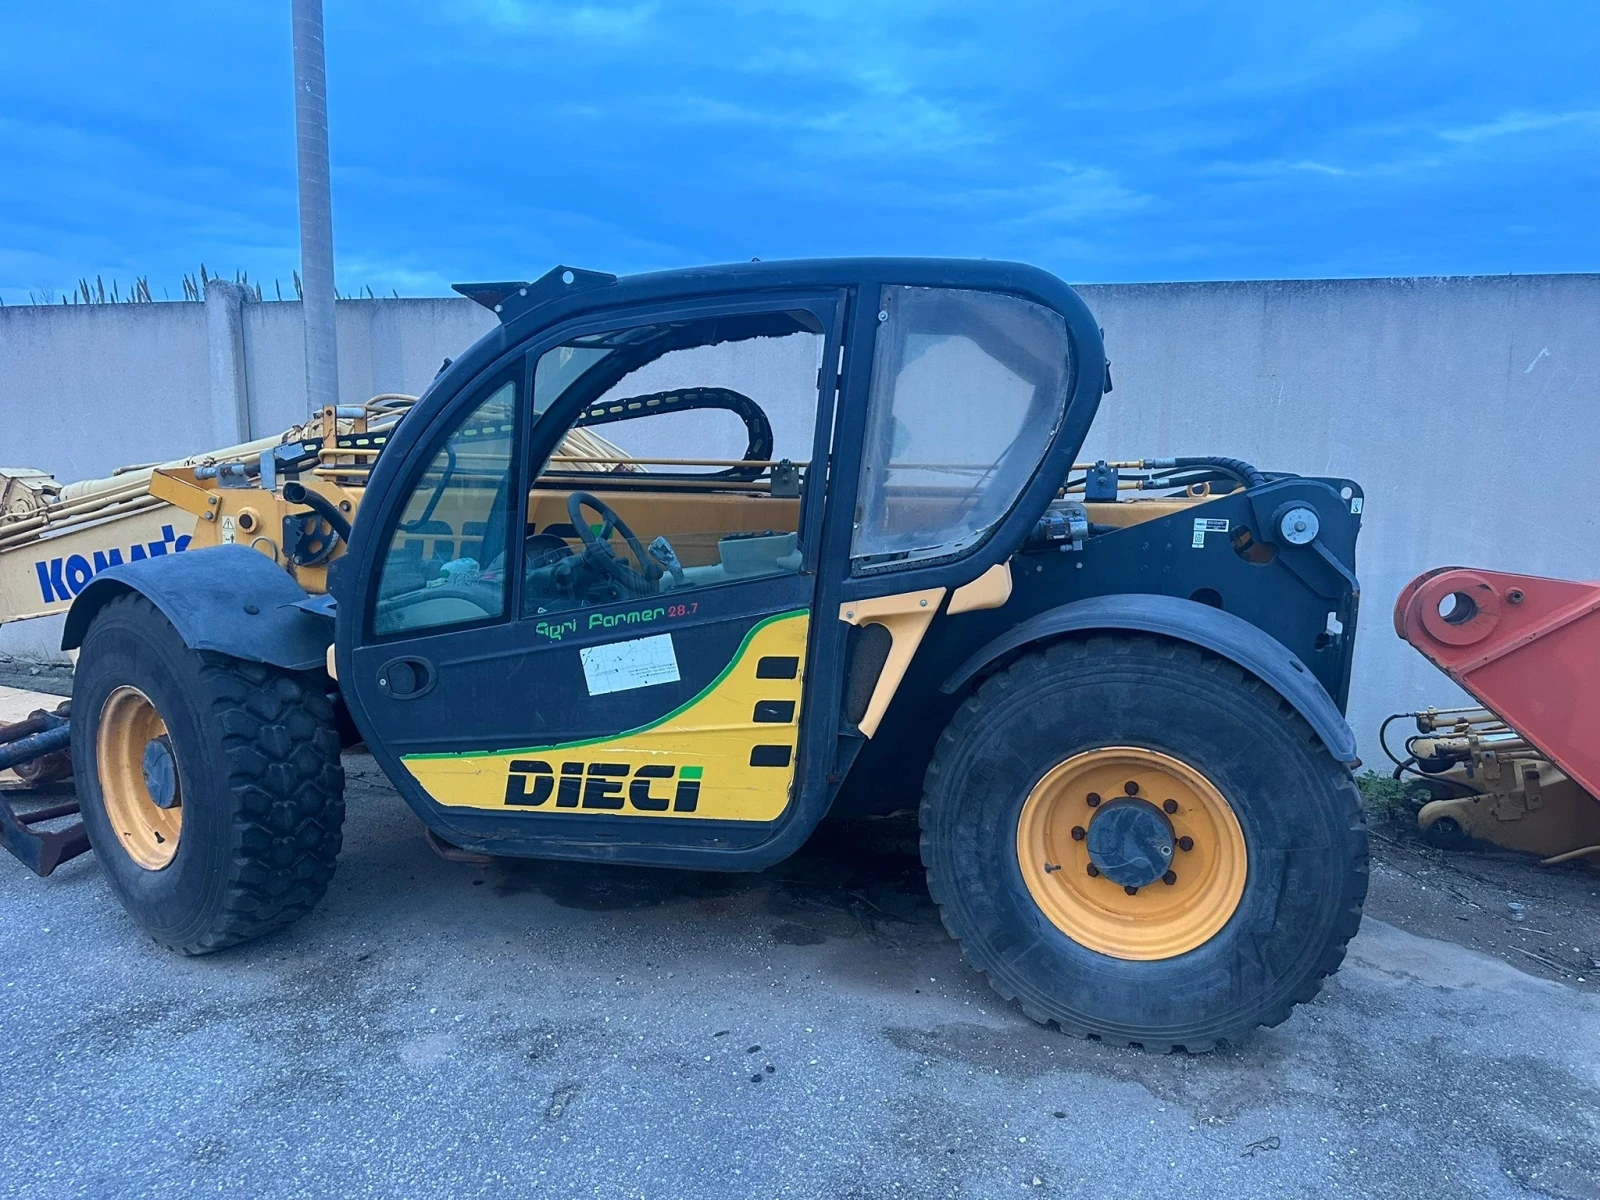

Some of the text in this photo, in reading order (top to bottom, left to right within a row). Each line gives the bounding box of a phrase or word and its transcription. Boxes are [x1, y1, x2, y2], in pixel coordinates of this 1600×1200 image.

[589, 608, 665, 630] Farmer
[667, 602, 699, 618] 28.7
[504, 760, 704, 812] DIECI
